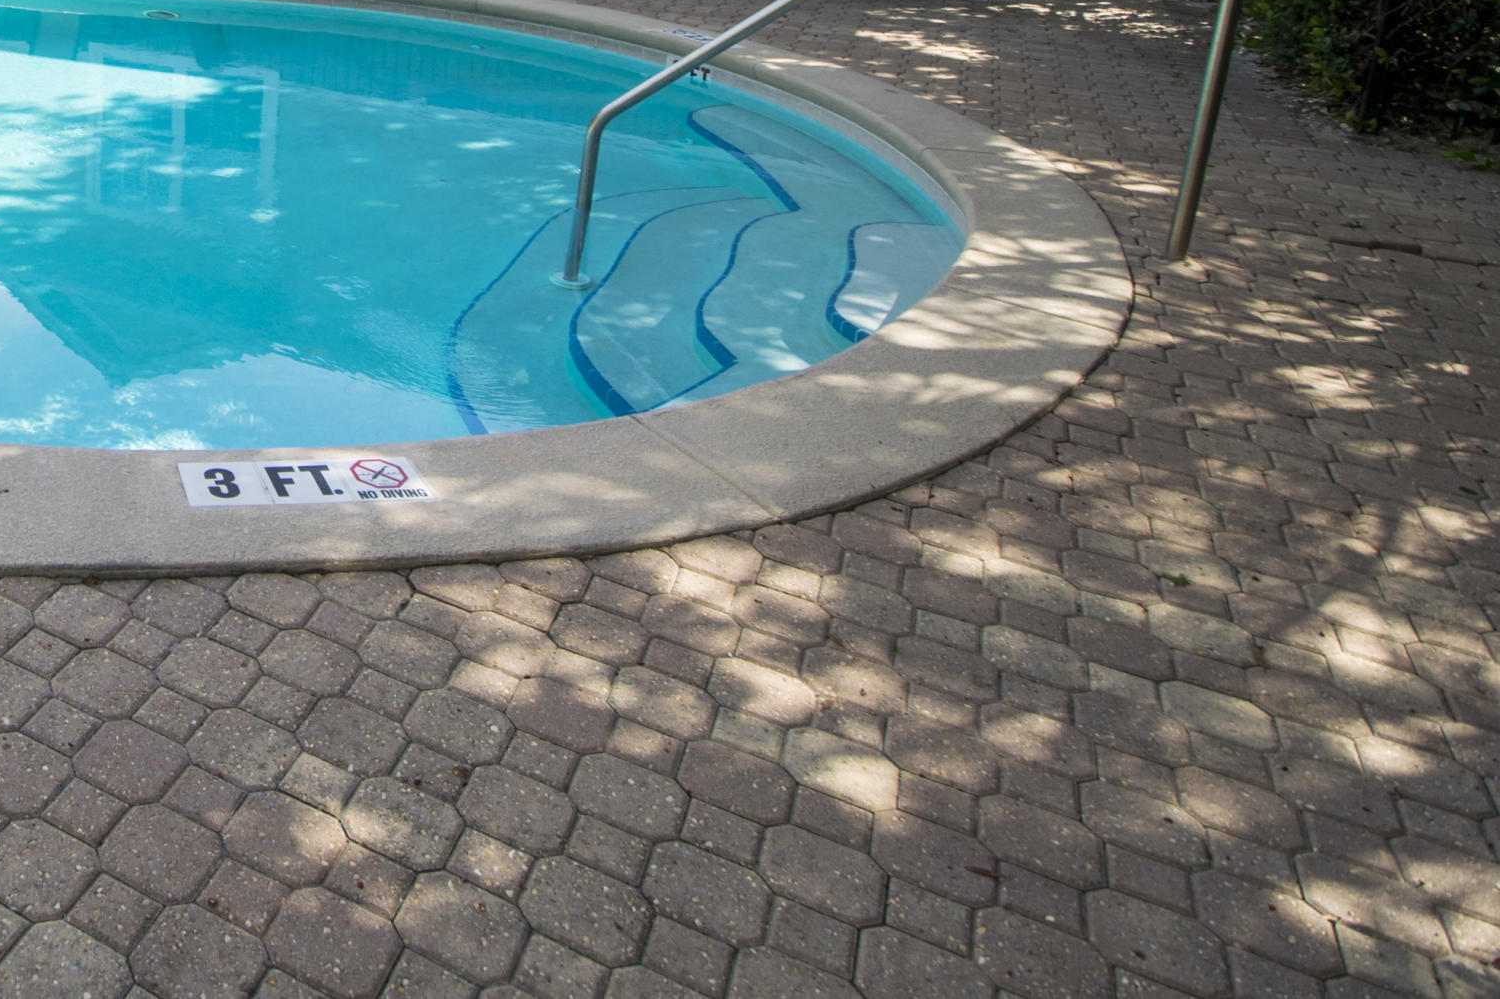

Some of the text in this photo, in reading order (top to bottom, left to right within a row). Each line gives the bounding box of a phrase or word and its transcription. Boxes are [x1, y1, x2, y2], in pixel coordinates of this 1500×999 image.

[203, 464, 345, 499] 3 FT.
[357, 487, 428, 500] NO DIVING
